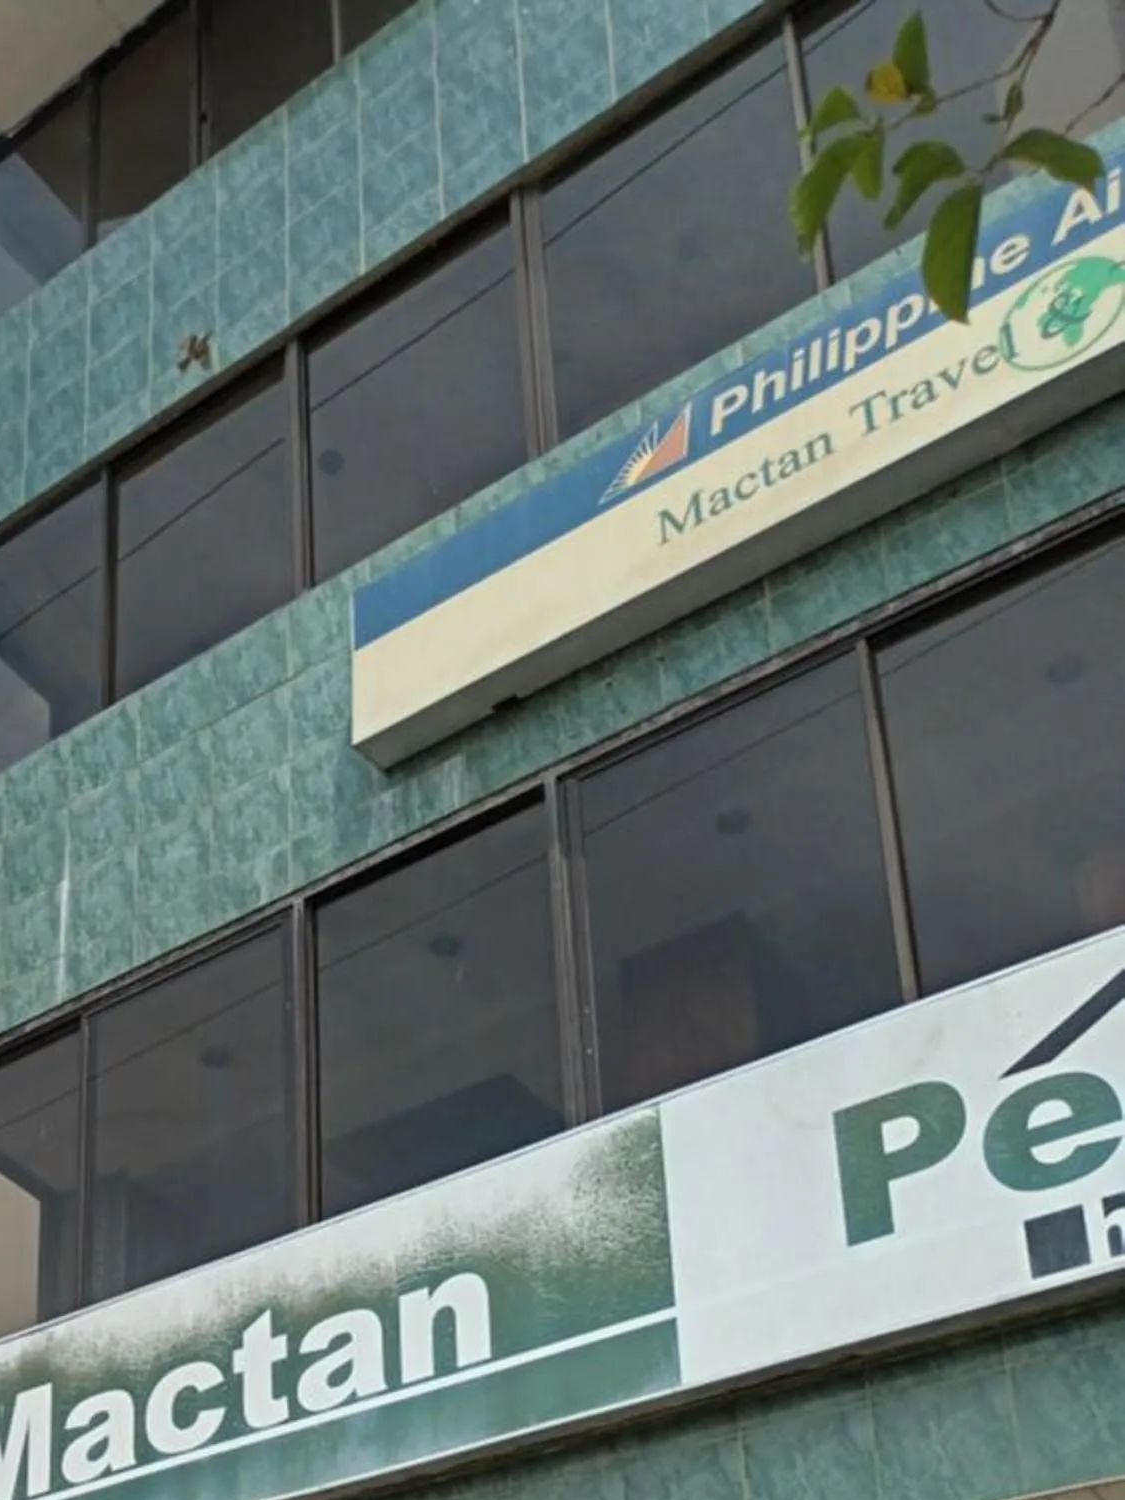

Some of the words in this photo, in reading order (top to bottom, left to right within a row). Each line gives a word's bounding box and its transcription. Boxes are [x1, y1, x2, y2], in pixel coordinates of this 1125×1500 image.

[710, 236, 1030, 436] Philippe
[1051, 166, 1123, 247] Ai
[657, 431, 834, 547] Mactan
[849, 321, 1018, 437] Travel
[832, 1071, 1124, 1248] Pe
